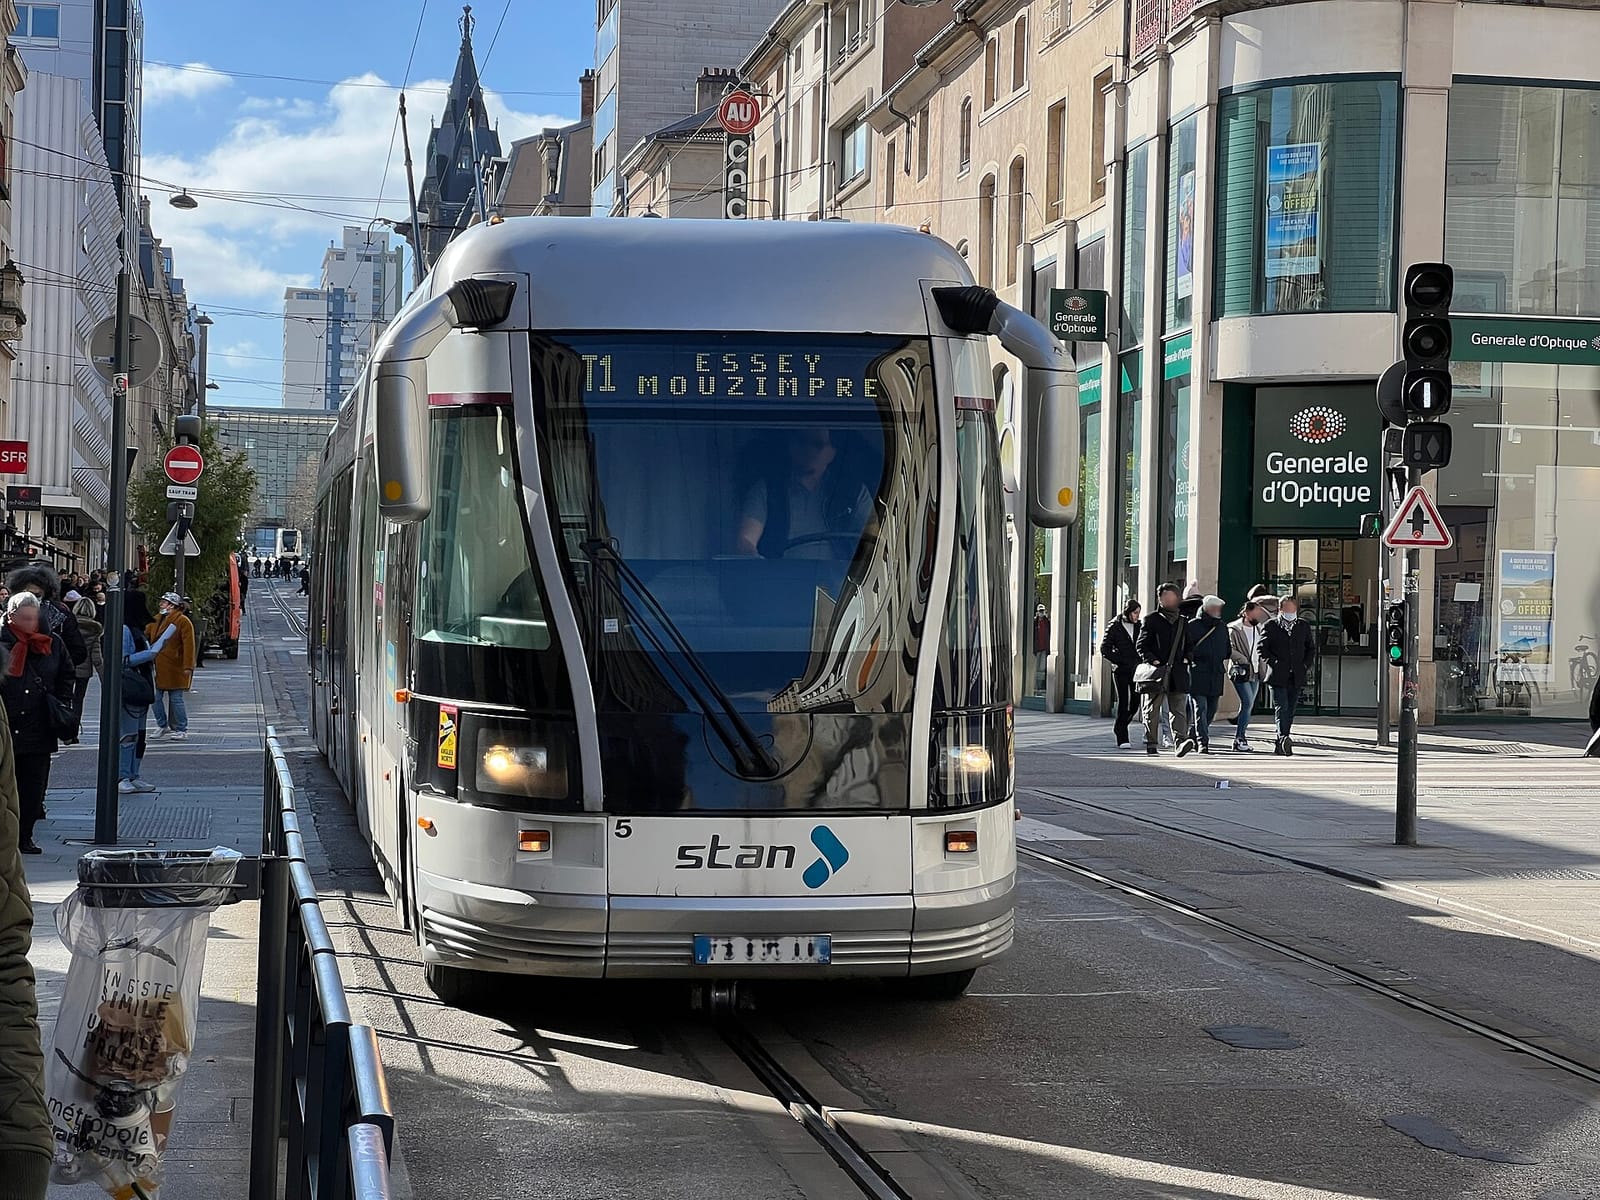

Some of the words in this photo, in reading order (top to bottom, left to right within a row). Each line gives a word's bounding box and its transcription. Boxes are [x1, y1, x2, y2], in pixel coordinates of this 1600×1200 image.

[726, 102, 752, 122] AU
[1055, 312, 1097, 323] Generale
[1053, 323, 1097, 334] d'Optique
[1471, 333, 1526, 347] Generale
[1529, 335, 1588, 351] d'Optique
[582, 354, 616, 392] T1
[696, 353, 821, 373] ESSEY
[638, 375, 878, 397] MOUZIMPRE
[1, 450, 27, 463] SFR
[1267, 451, 1369, 474] Generale
[1262, 480, 1371, 507] d'Optique
[1518, 605, 1552, 615] OFFERT
[614, 819, 633, 839] 5
[675, 834, 796, 869] stan
